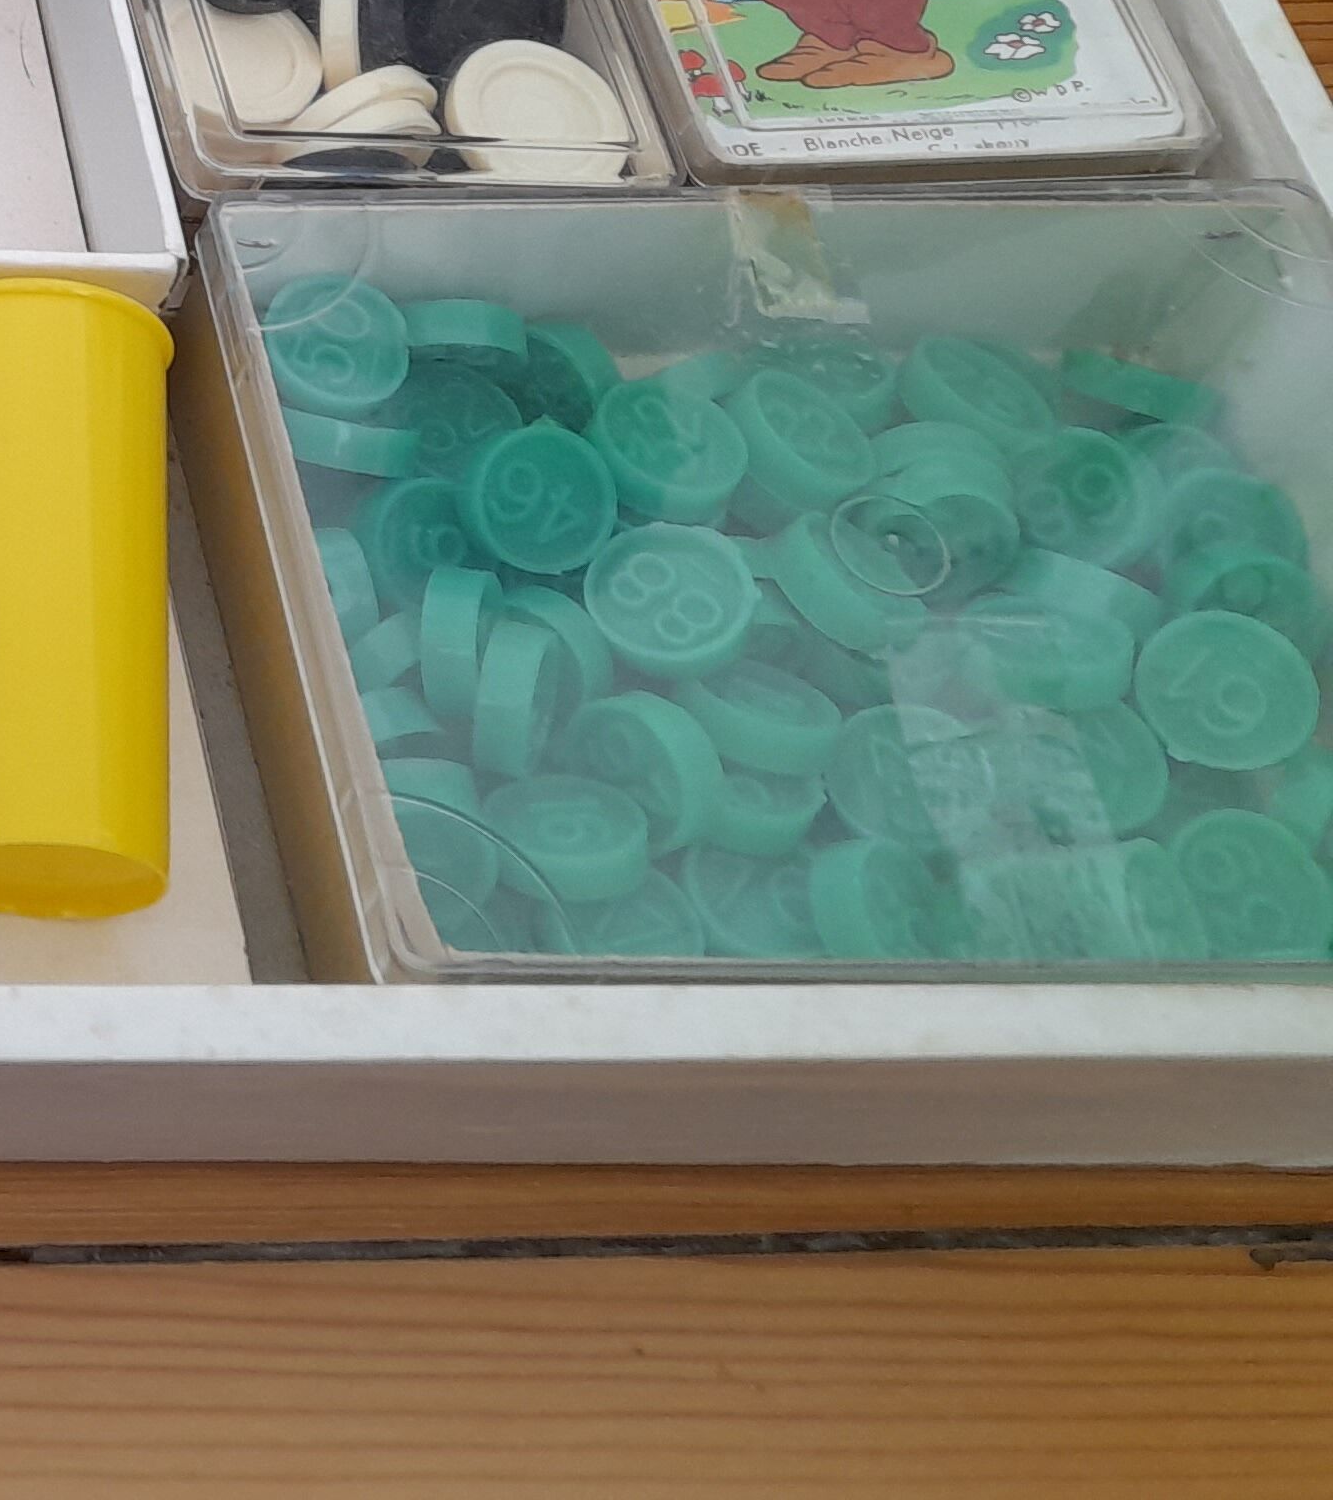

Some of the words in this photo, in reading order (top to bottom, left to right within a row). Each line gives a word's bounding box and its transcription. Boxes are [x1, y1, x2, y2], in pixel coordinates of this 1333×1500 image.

[803, 131, 883, 152] Blanche
[892, 125, 955, 143] Neige
[609, 552, 724, 643] 88
